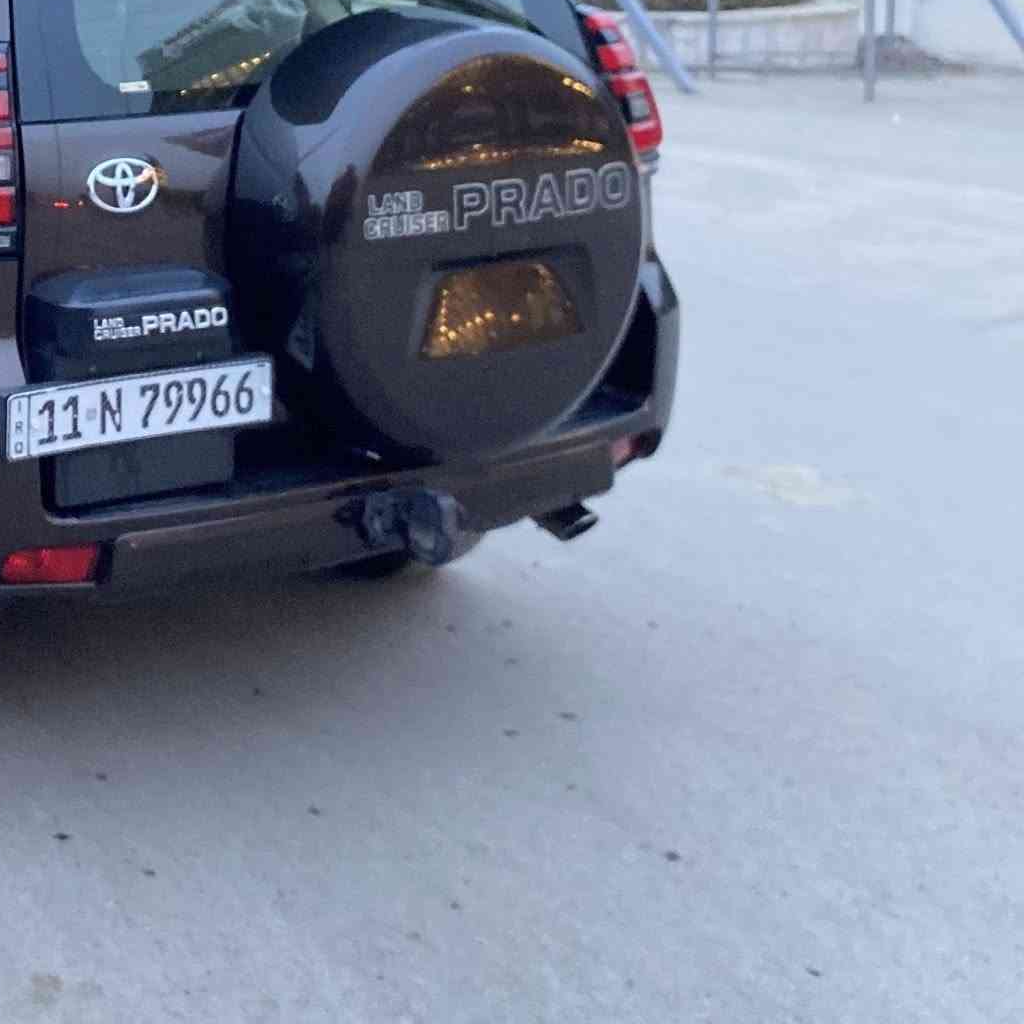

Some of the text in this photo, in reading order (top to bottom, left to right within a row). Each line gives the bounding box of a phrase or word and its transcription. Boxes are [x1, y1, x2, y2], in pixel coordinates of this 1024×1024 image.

[368, 190, 423, 215] LAND
[452, 161, 632, 231] PRADO
[363, 210, 449, 240] CRUISER
[93, 317, 124, 329] LAND
[94, 326, 141, 341] CRUISER
[141, 307, 227, 335] PRADO
[38, 371, 254, 445] 11 N 79966
